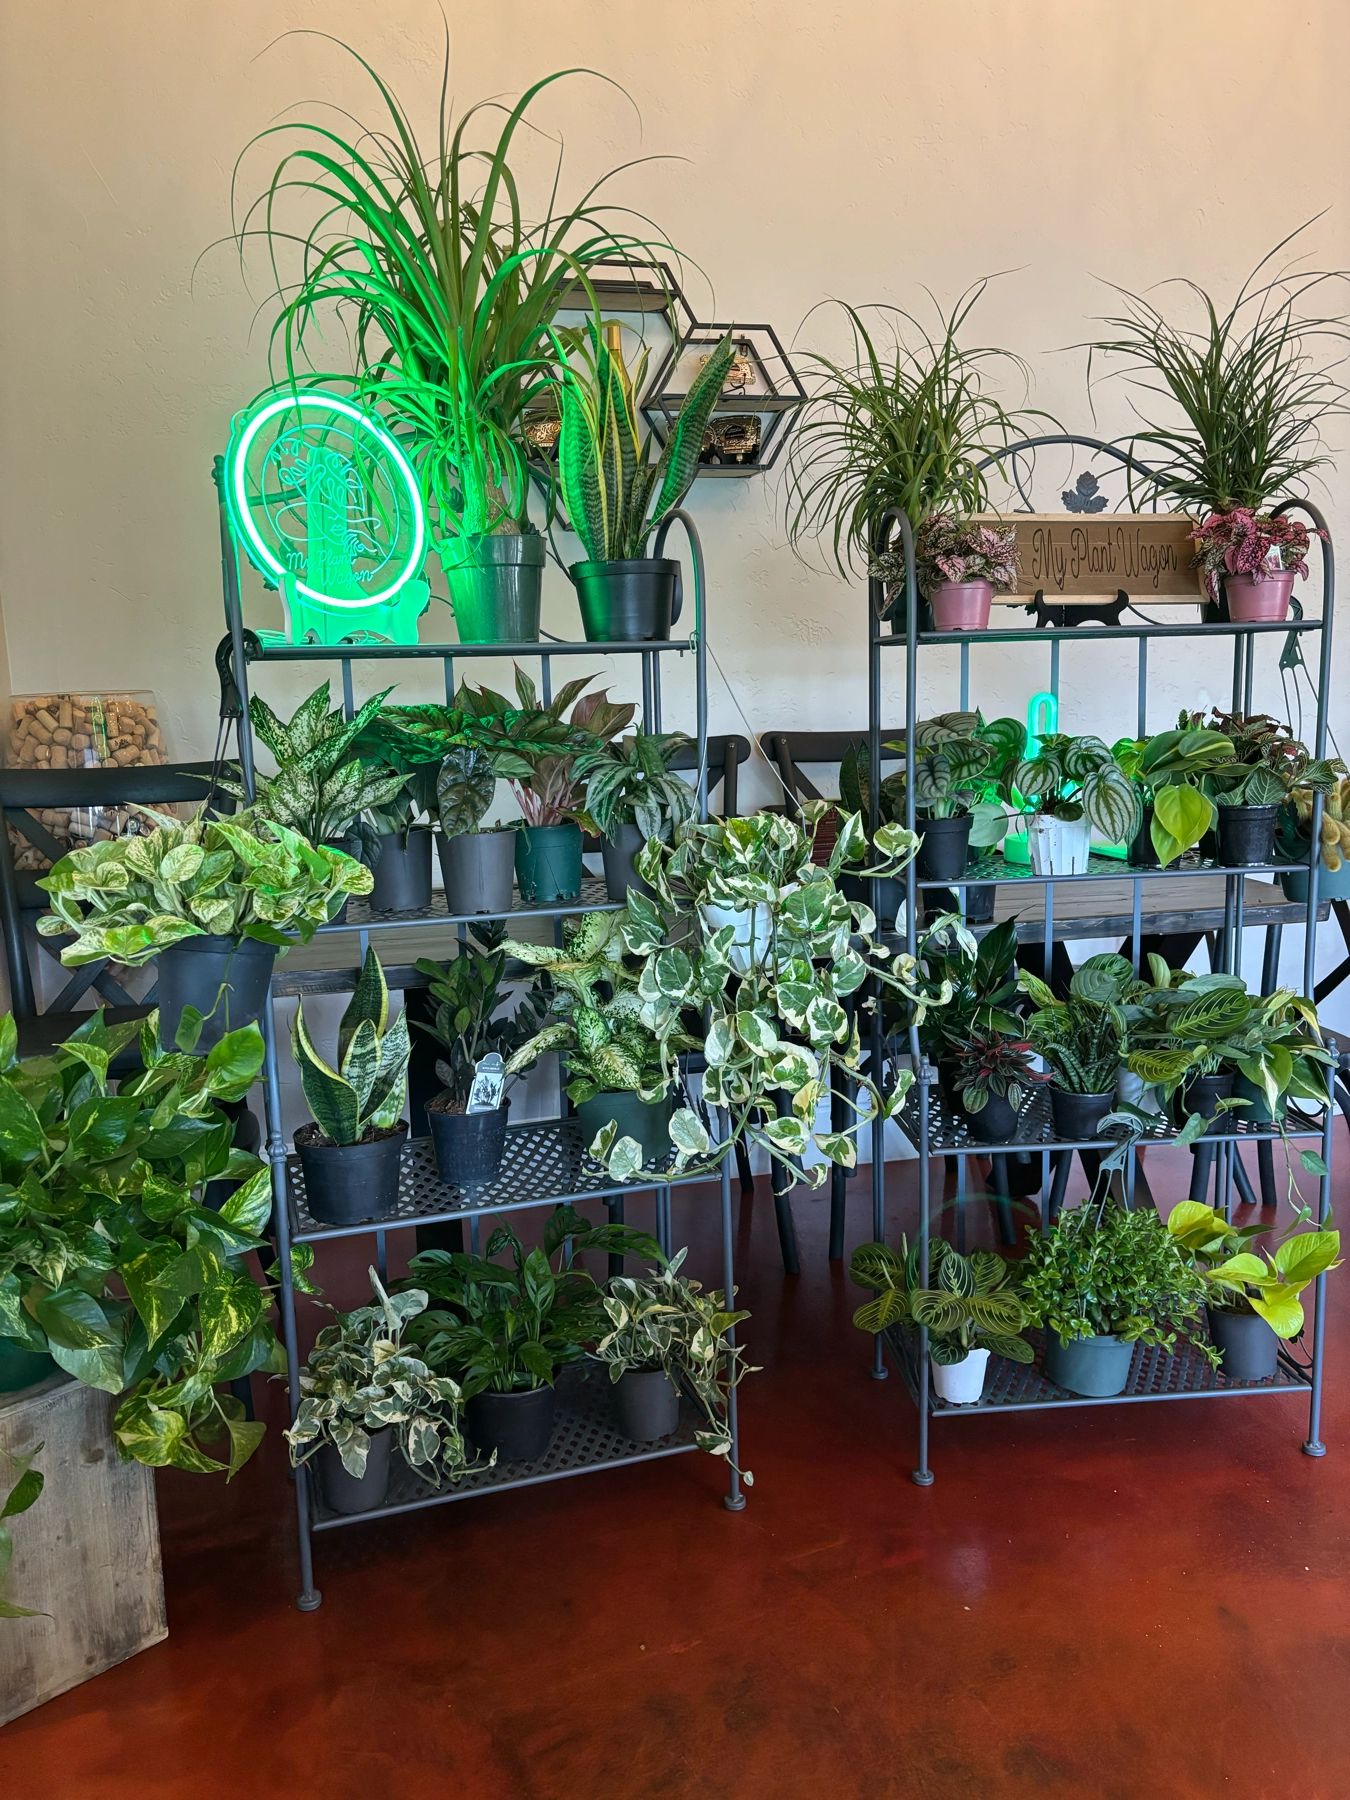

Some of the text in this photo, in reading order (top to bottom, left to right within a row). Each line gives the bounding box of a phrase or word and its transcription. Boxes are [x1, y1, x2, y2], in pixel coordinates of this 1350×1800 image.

[316, 566, 374, 592] Wagon
[1031, 526, 1178, 591] My Plant Wagon
